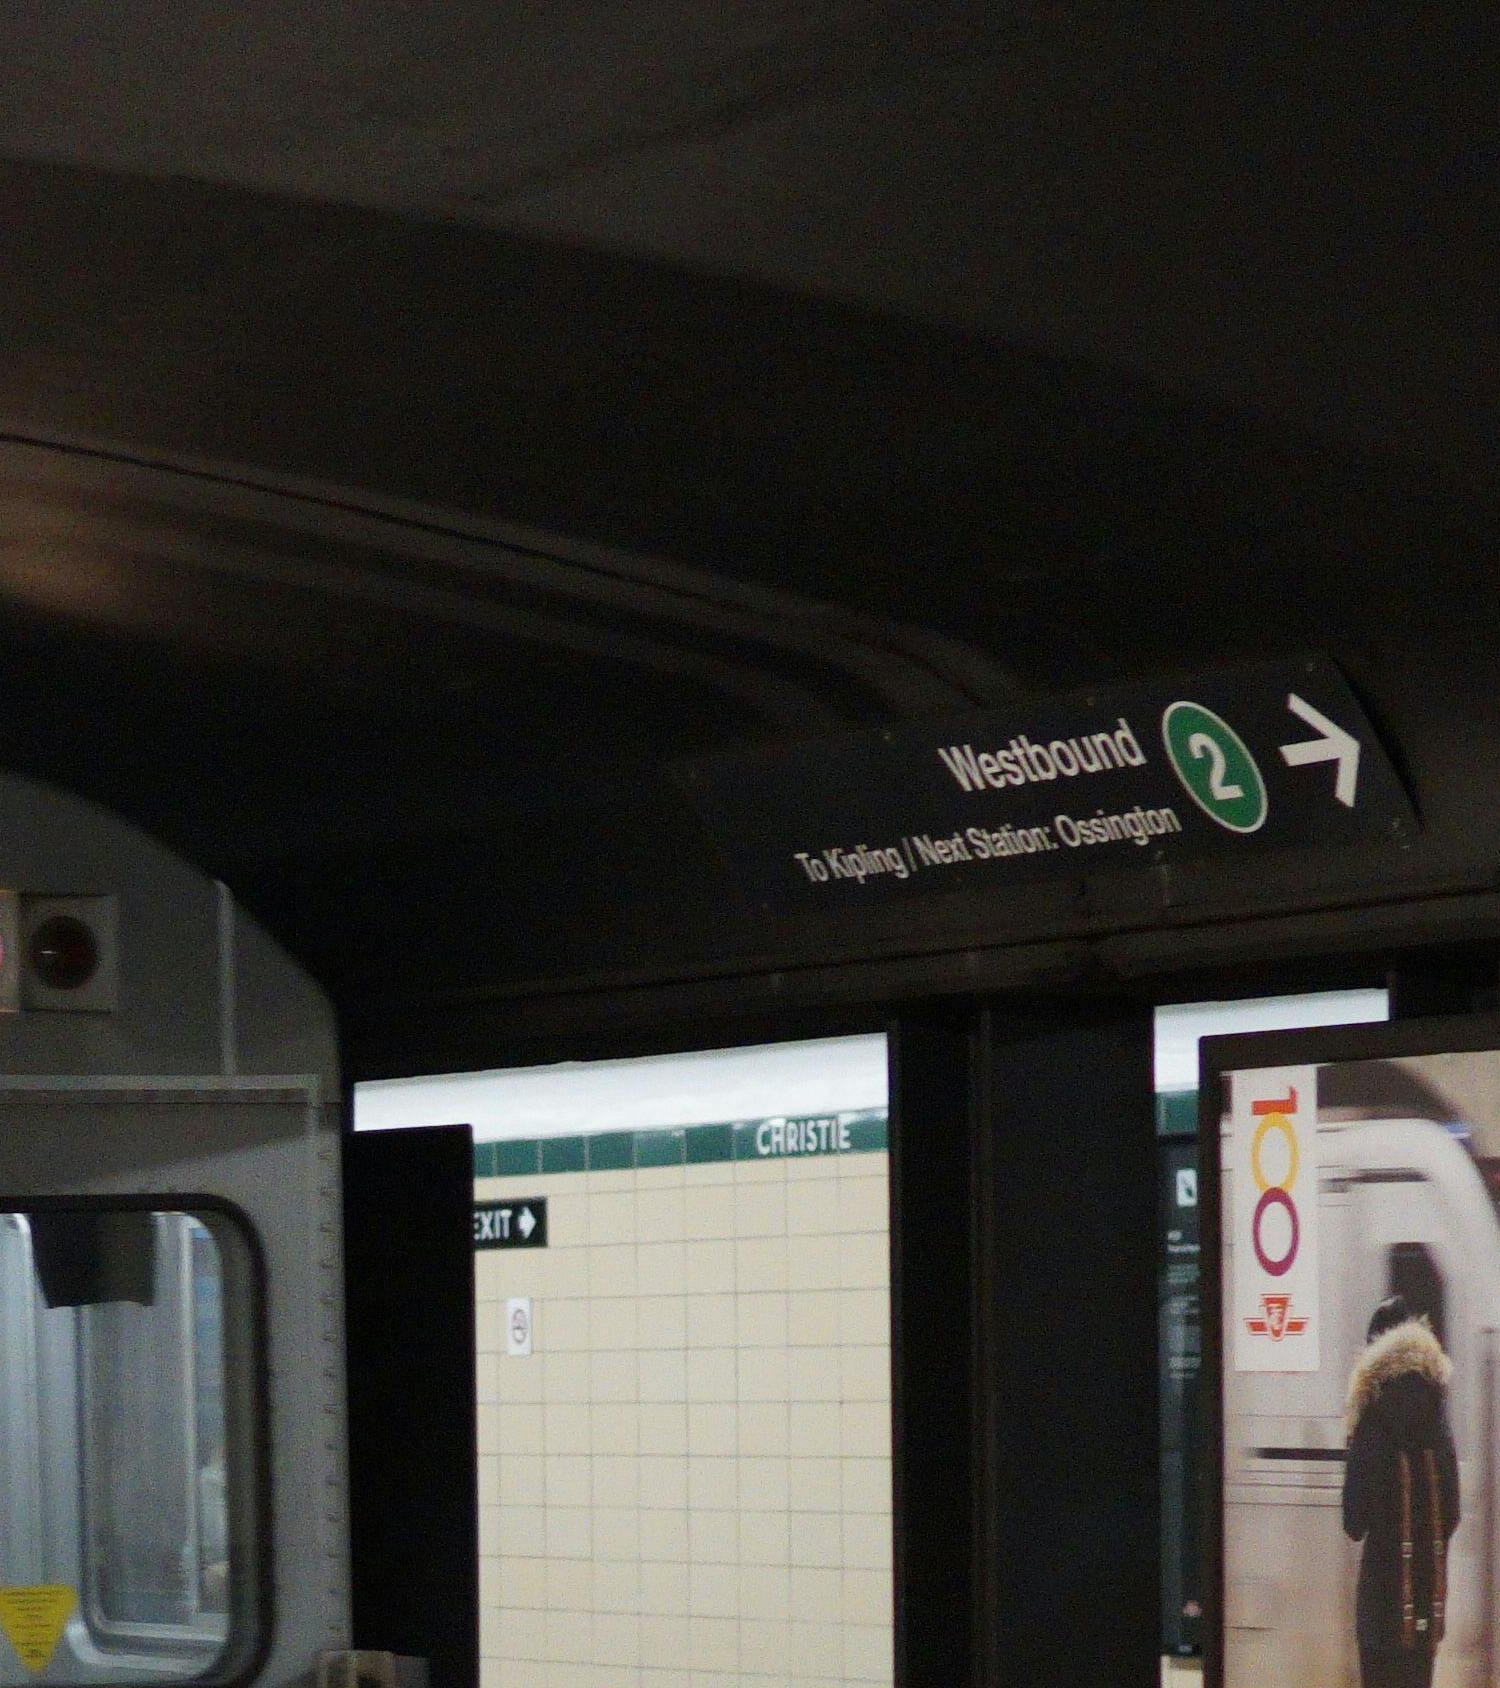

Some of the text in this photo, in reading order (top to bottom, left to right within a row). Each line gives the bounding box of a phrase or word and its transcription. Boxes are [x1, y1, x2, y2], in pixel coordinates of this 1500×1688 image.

[937, 717, 1244, 801] Westbound 2
[794, 852, 829, 883] To
[822, 842, 909, 885] Kipling
[912, 832, 965, 867] Next
[965, 822, 1060, 860] Station:
[1052, 804, 1183, 848] Ossington
[756, 1115, 852, 1156] CHRISTIE
